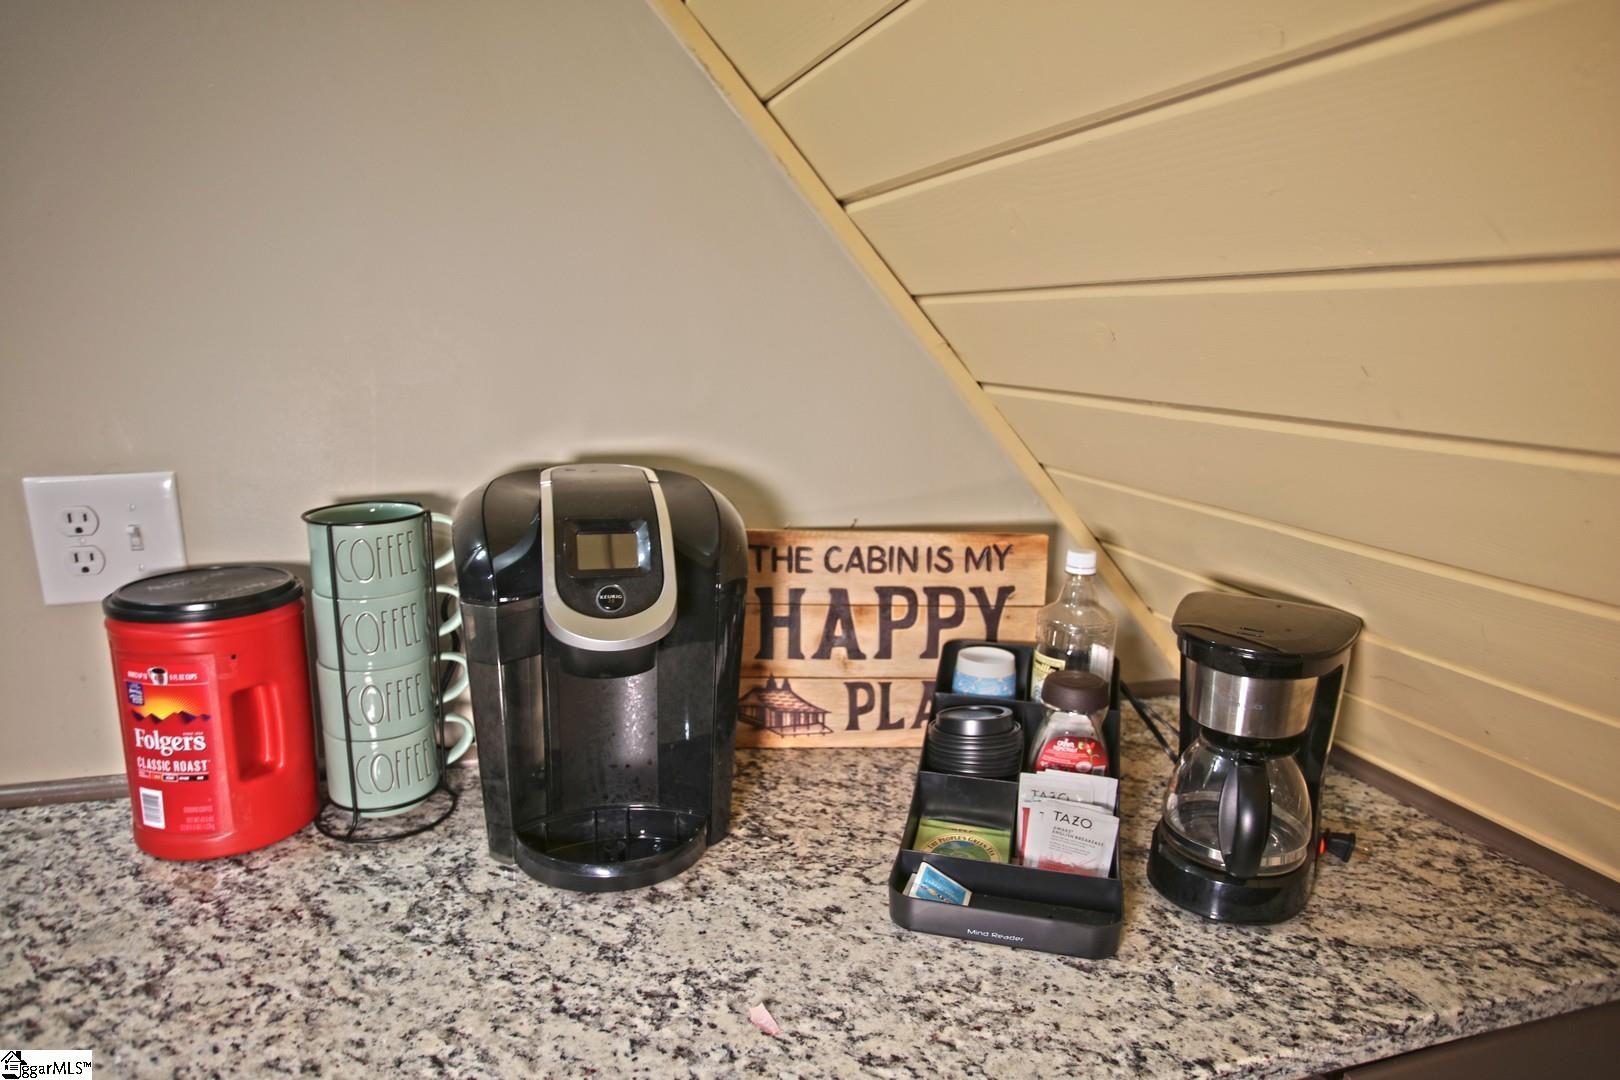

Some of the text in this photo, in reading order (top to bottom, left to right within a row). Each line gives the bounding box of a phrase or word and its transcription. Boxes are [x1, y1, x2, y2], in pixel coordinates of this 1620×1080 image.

[335, 530, 418, 583] COFFEE
[747, 543, 1015, 575] THE CABIN IS MY
[341, 602, 422, 656] COFFEE
[754, 585, 1016, 660] HAPPY
[345, 672, 425, 726] COFFEE
[134, 728, 206, 757] Folgers
[137, 756, 207, 772] CLASSIC ROAST
[356, 737, 433, 795] COFFEE
[1053, 810, 1093, 829] TAZO
[967, 929, 1024, 942] Mind Reader
